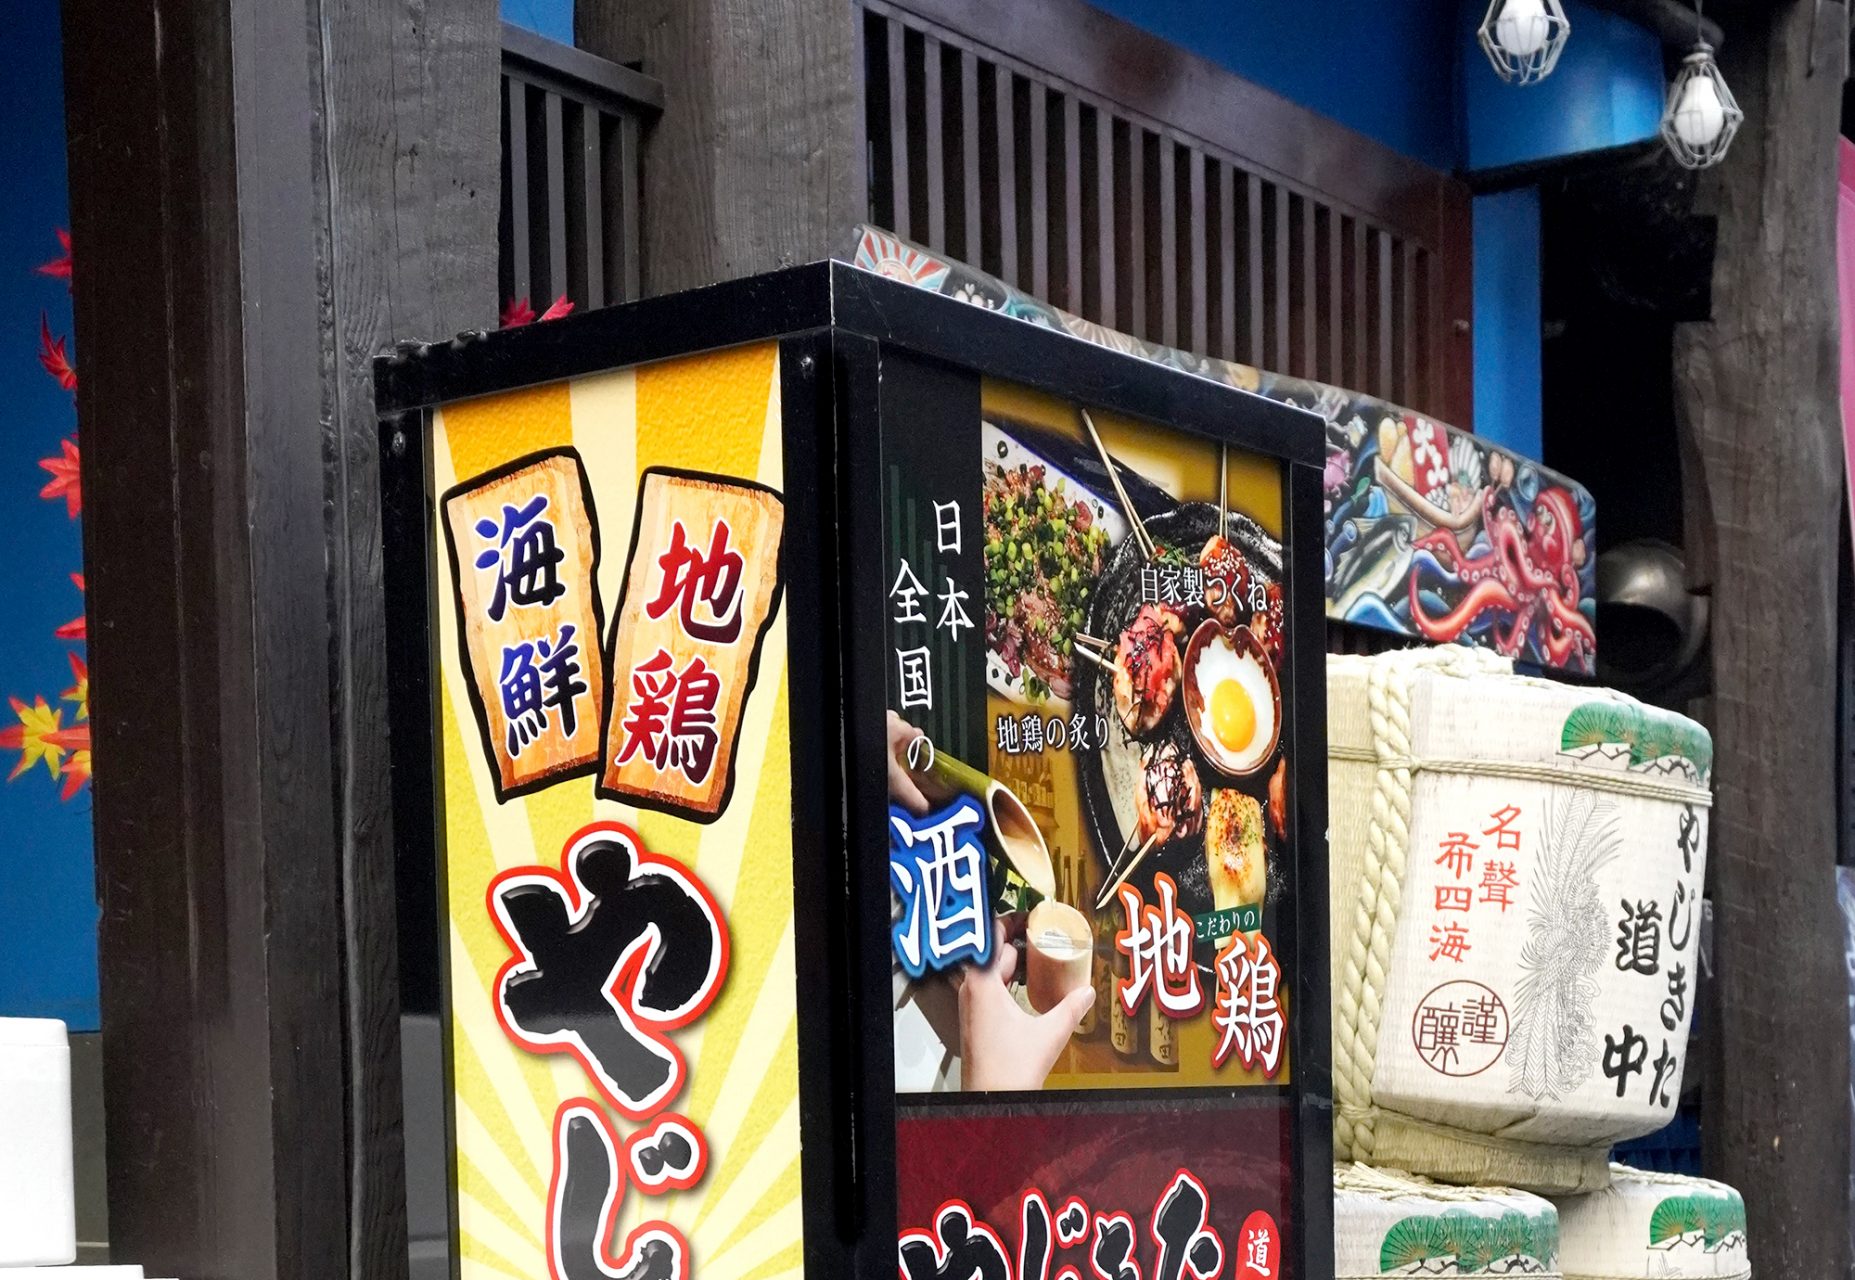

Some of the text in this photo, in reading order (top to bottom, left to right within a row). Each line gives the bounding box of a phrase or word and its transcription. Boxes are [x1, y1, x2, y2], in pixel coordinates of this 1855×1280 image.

[474, 496, 588, 757] 海鮮
[615, 517, 745, 784] 地鶏
[933, 500, 975, 642] 日本
[1139, 562, 1268, 612] 自家製つくね
[889, 558, 935, 772] 全国の
[997, 713, 1109, 753] 地鶏の炙り
[891, 804, 985, 967] 酒
[1197, 911, 1255, 938] こだわりの
[1429, 832, 1479, 964] 希四海
[1478, 804, 1522, 911] 名聲
[1120, 879, 1285, 1071] 地鶏
[1602, 900, 1662, 1097] 道中
[1649, 804, 1701, 1109] やじきた
